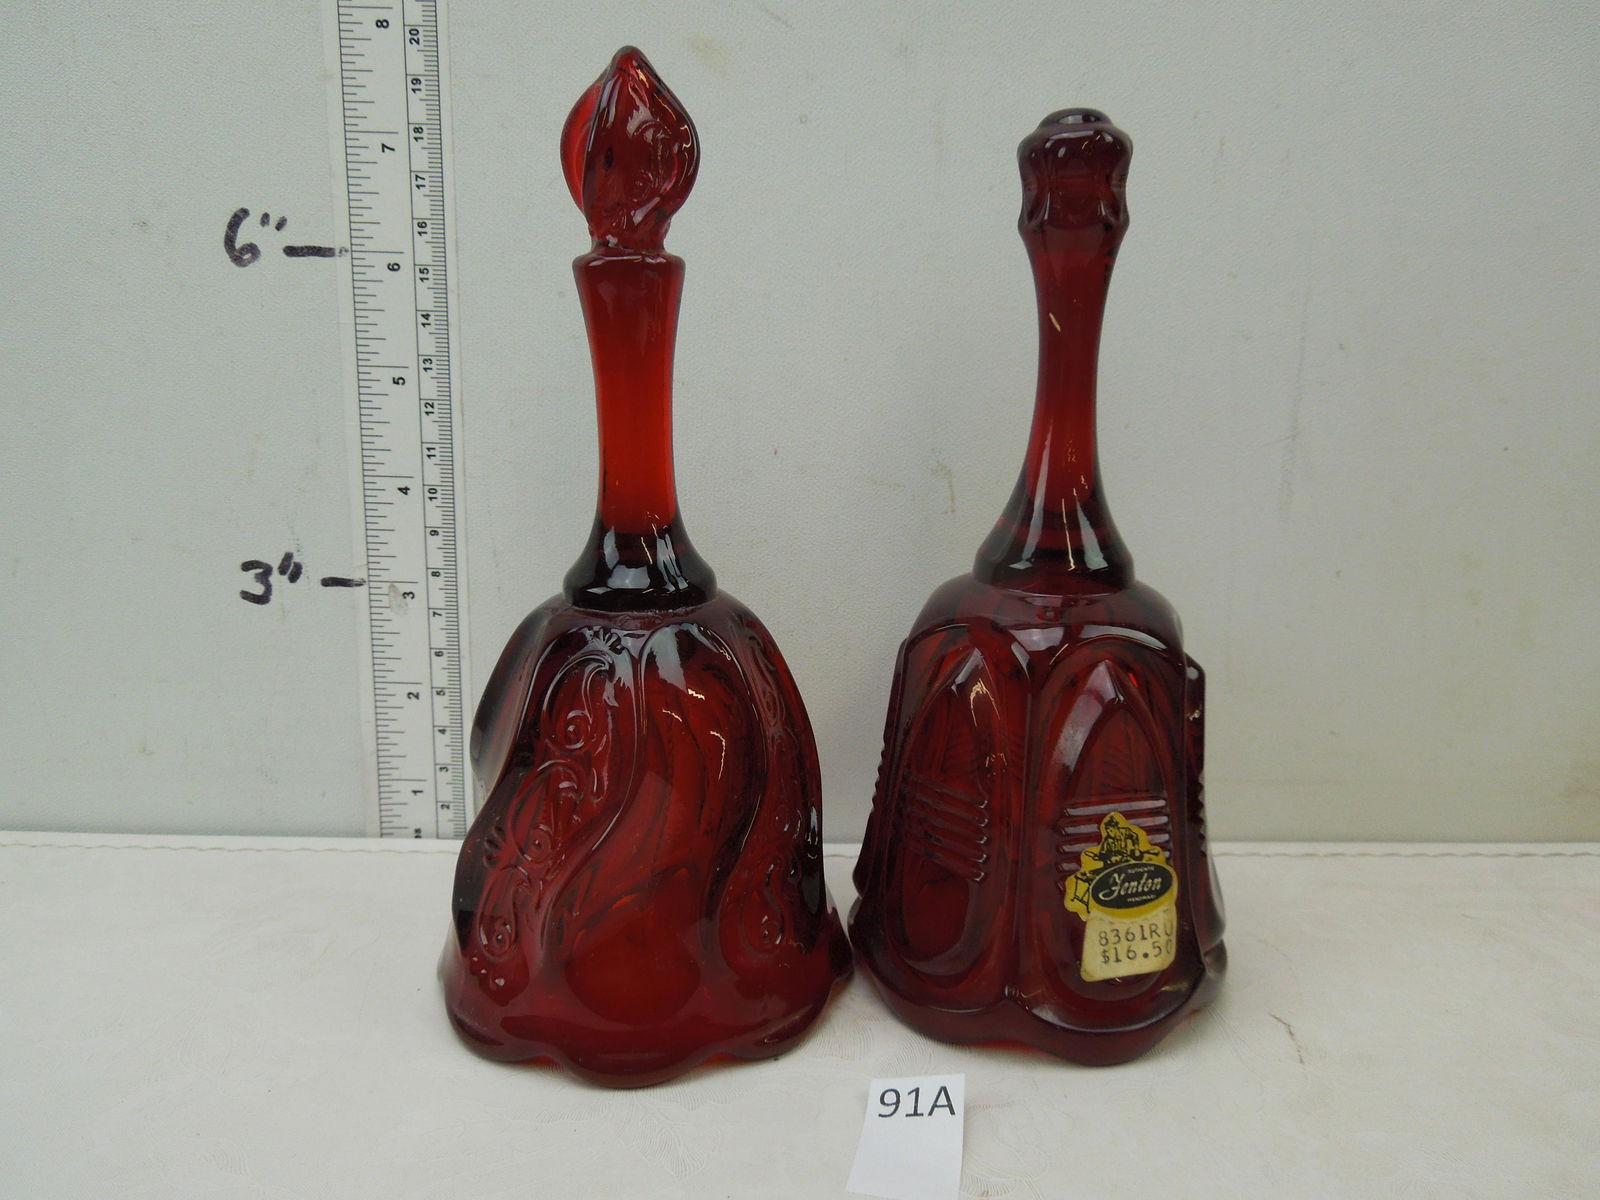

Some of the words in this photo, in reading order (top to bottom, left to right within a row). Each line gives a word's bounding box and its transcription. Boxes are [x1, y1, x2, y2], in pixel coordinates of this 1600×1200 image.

[376, 19, 389, 28] 8
[409, 28, 419, 45] 20
[411, 78, 422, 93] 19
[413, 126, 424, 142] 18
[382, 143, 395, 153] 7
[416, 174, 426, 189] 17
[417, 221, 427, 236] 16
[387, 262, 401, 272] 6
[420, 267, 429, 282] 15
[421, 313, 431, 328] 14
[423, 358, 433, 372] 13
[393, 376, 406, 386] 5
[425, 401, 435, 416] 12
[427, 446, 436, 459] 11
[398, 486, 411, 495] 4
[428, 487, 438, 501] 10
[402, 591, 415, 599] 3
[407, 691, 419, 700] 2
[411, 788, 424, 796] 1
[1099, 873, 1162, 900] Fenton
[1099, 922, 1173, 946] 8361RU
[1102, 938, 1173, 964] $16.50
[878, 1086, 956, 1118] 91A
